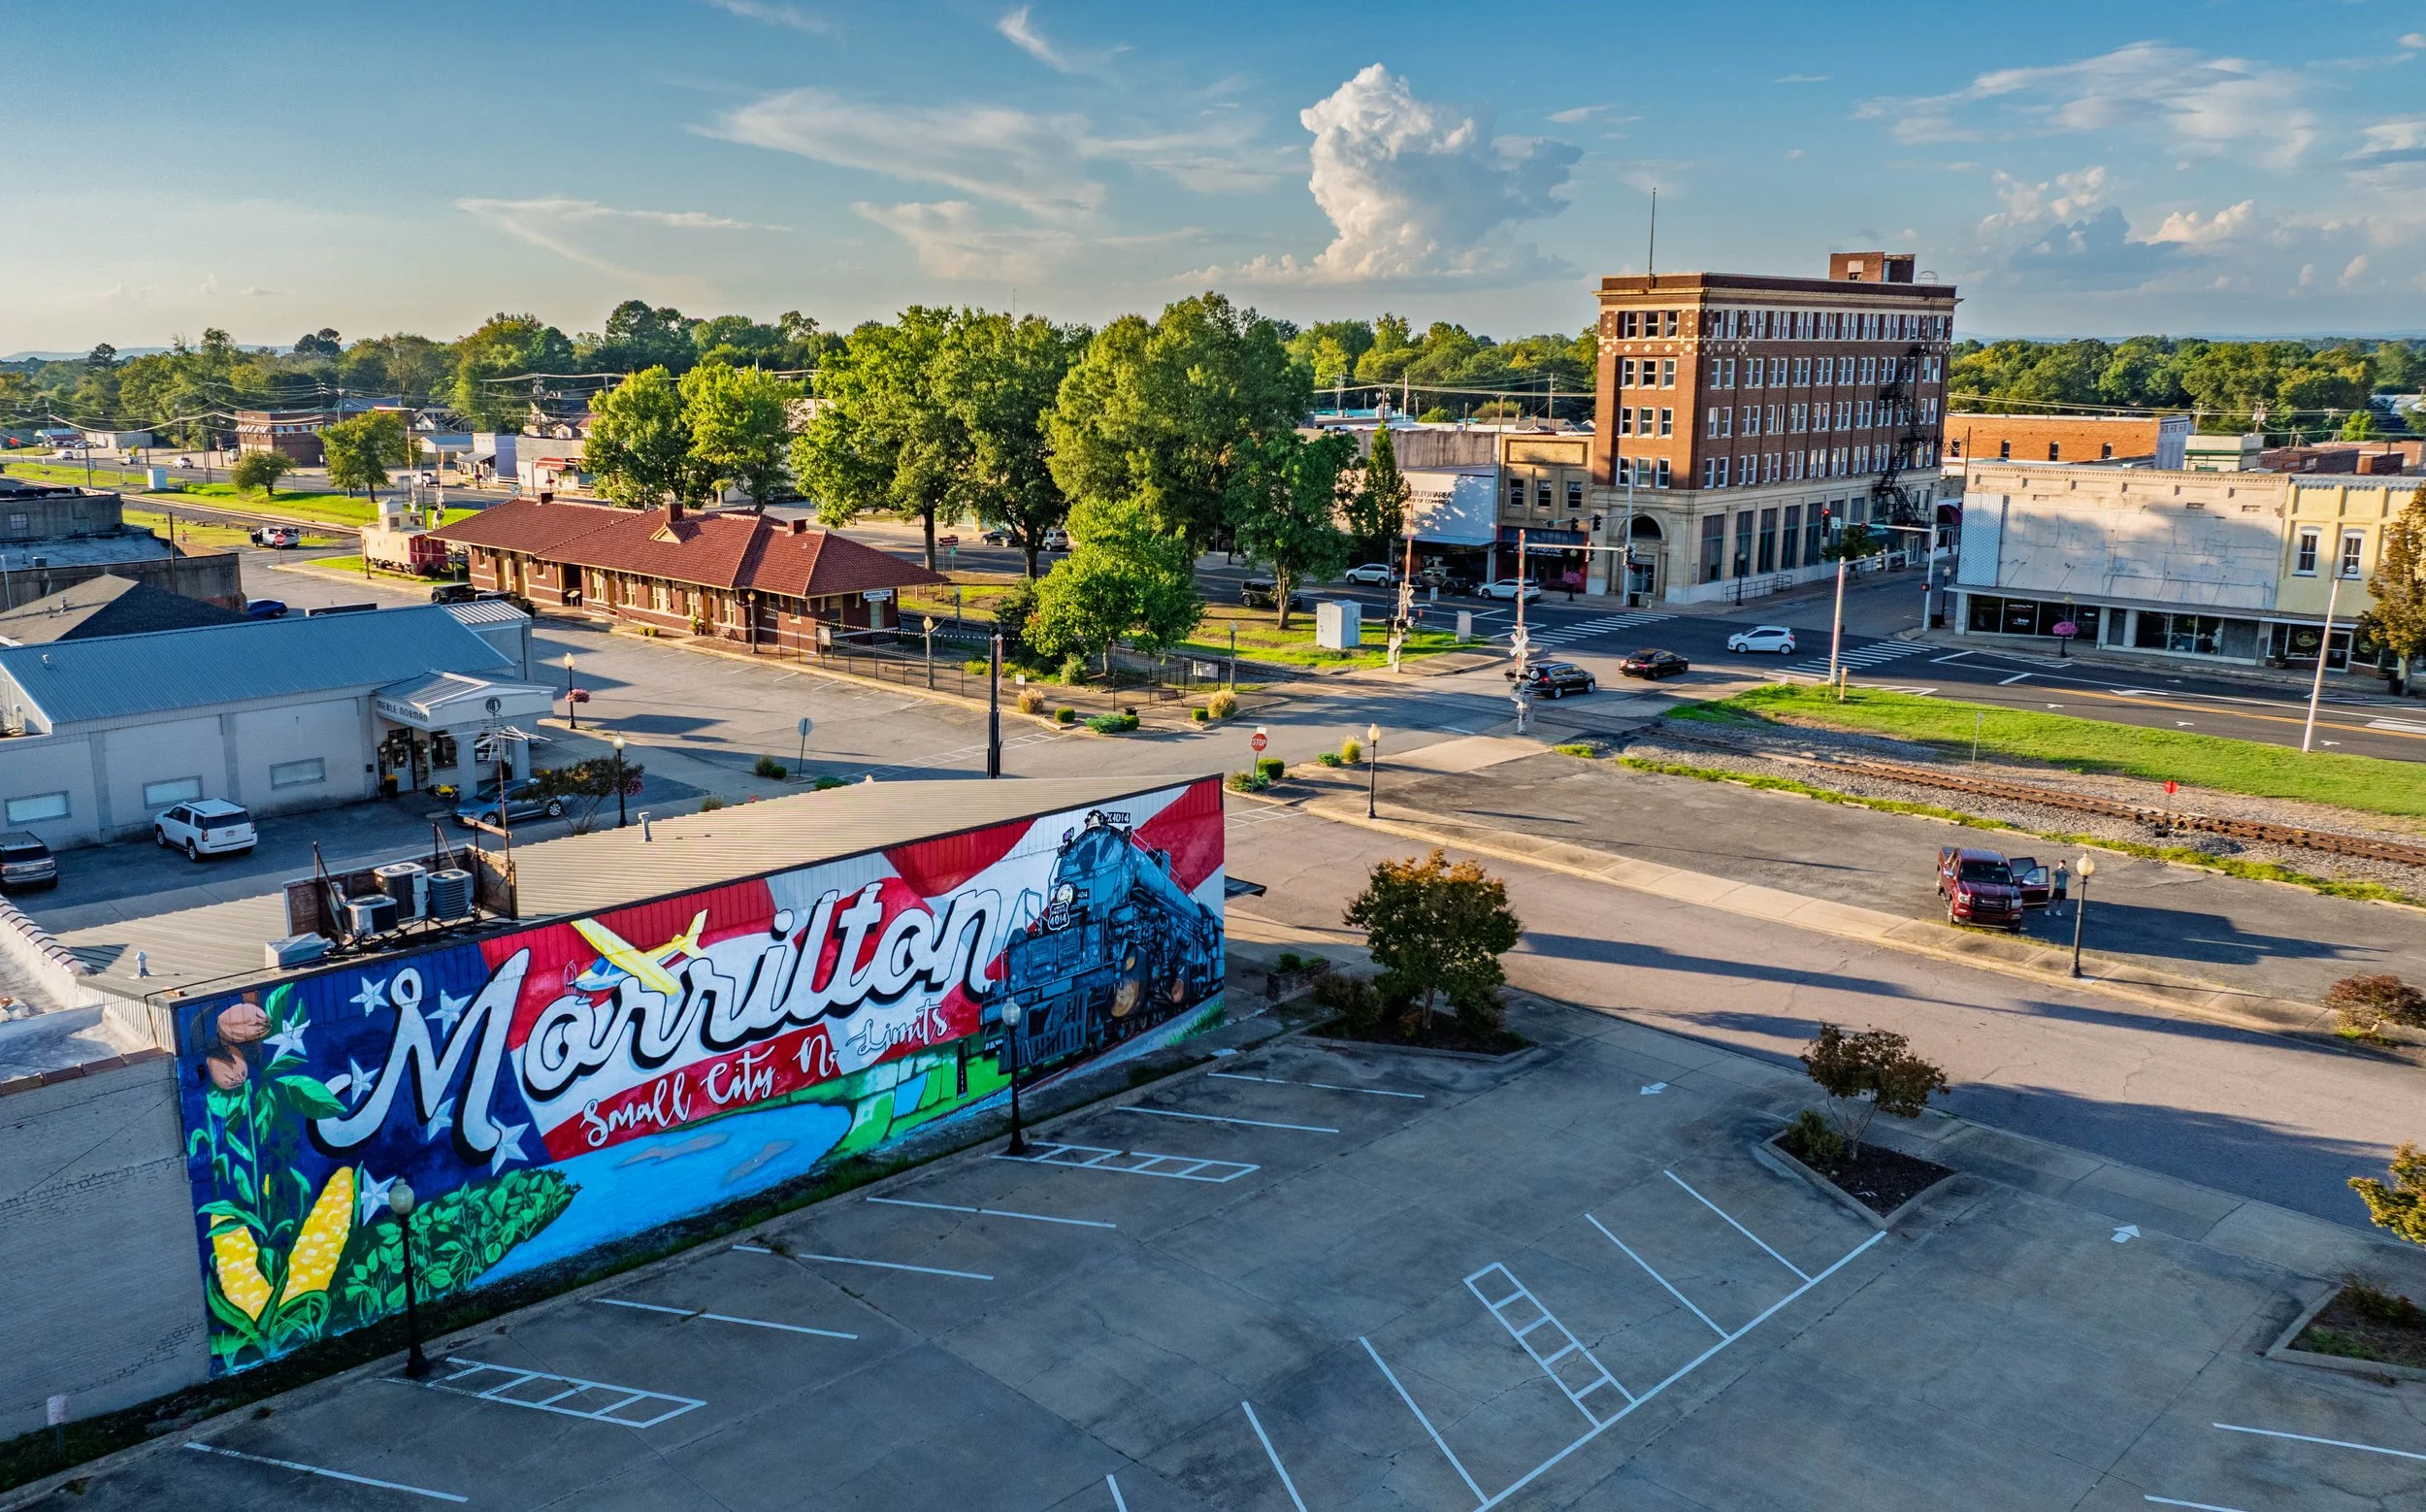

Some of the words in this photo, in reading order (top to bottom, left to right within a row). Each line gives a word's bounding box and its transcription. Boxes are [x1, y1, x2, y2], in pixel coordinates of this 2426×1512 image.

[377, 700, 397, 714] MERLE
[399, 707, 428, 723] NORMAN
[1107, 812, 1130, 823] X4014
[1049, 912, 1067, 926] 4014
[311, 879, 1000, 1159] Morrilton
[580, 1071, 692, 1147] Small
[793, 1035, 838, 1077] No
